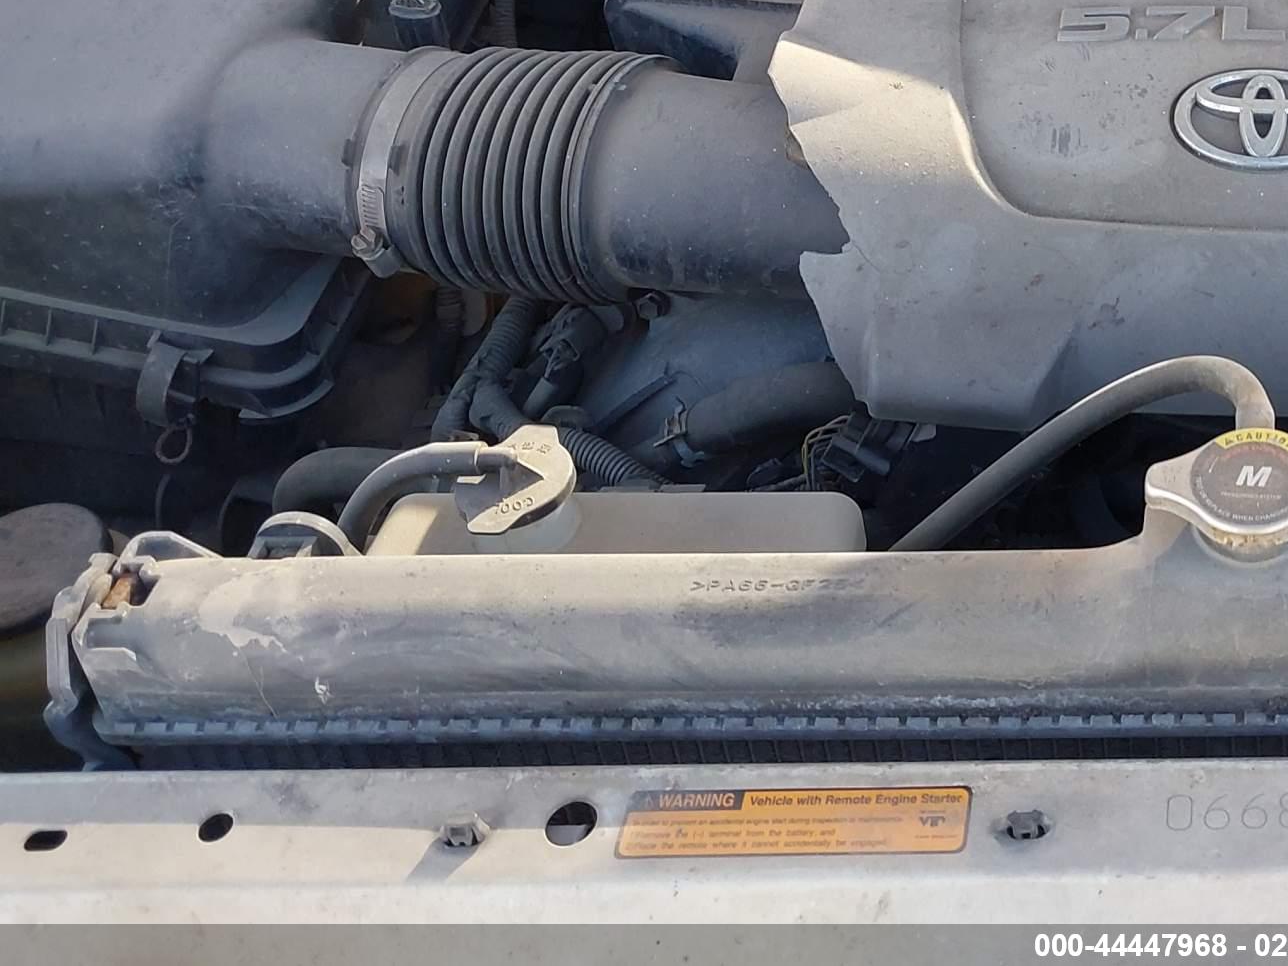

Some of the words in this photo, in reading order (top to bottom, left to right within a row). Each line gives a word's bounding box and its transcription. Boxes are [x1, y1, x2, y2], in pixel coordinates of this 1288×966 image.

[1057, 5, 1286, 42] 5.7L
[1235, 465, 1273, 489] M
[658, 792, 736, 809] WARNING
[750, 795, 793, 807] Vehicle
[796, 794, 822, 806] with
[825, 794, 872, 806] Remote
[875, 793, 917, 806] Engine
[920, 792, 963, 804] Starter
